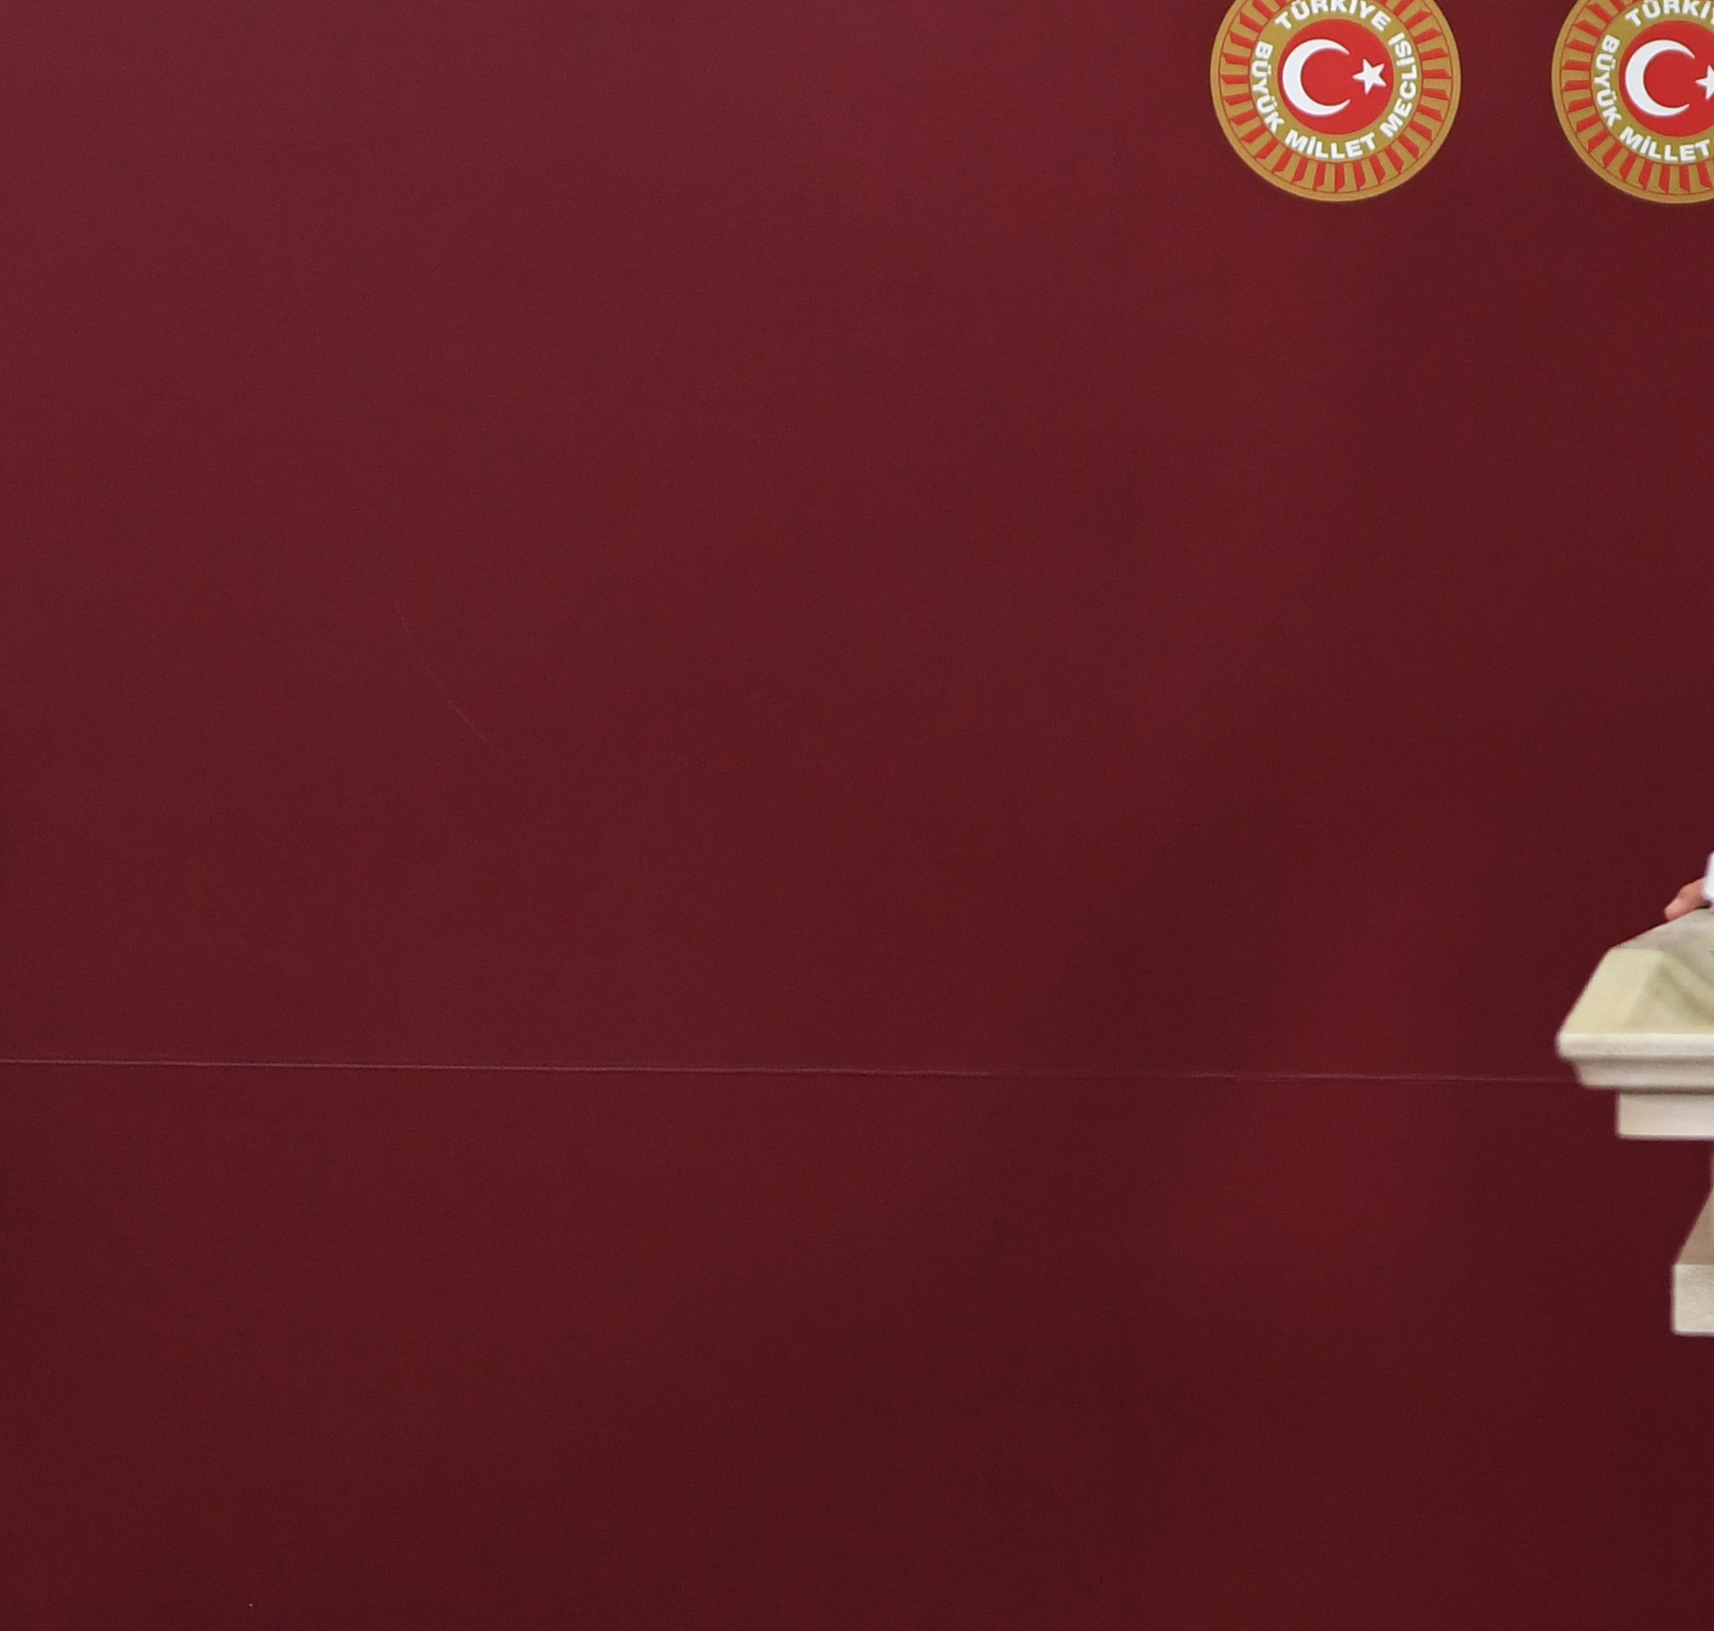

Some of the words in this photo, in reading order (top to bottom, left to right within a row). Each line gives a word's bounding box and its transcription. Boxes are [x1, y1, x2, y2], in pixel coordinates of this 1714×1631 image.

[1250, 41, 1285, 134] BÜYÜK
[1284, 129, 1376, 161] MİLLET
[1593, 34, 1622, 128] BÜYÜK
[1619, 126, 1711, 162] MİLLET
